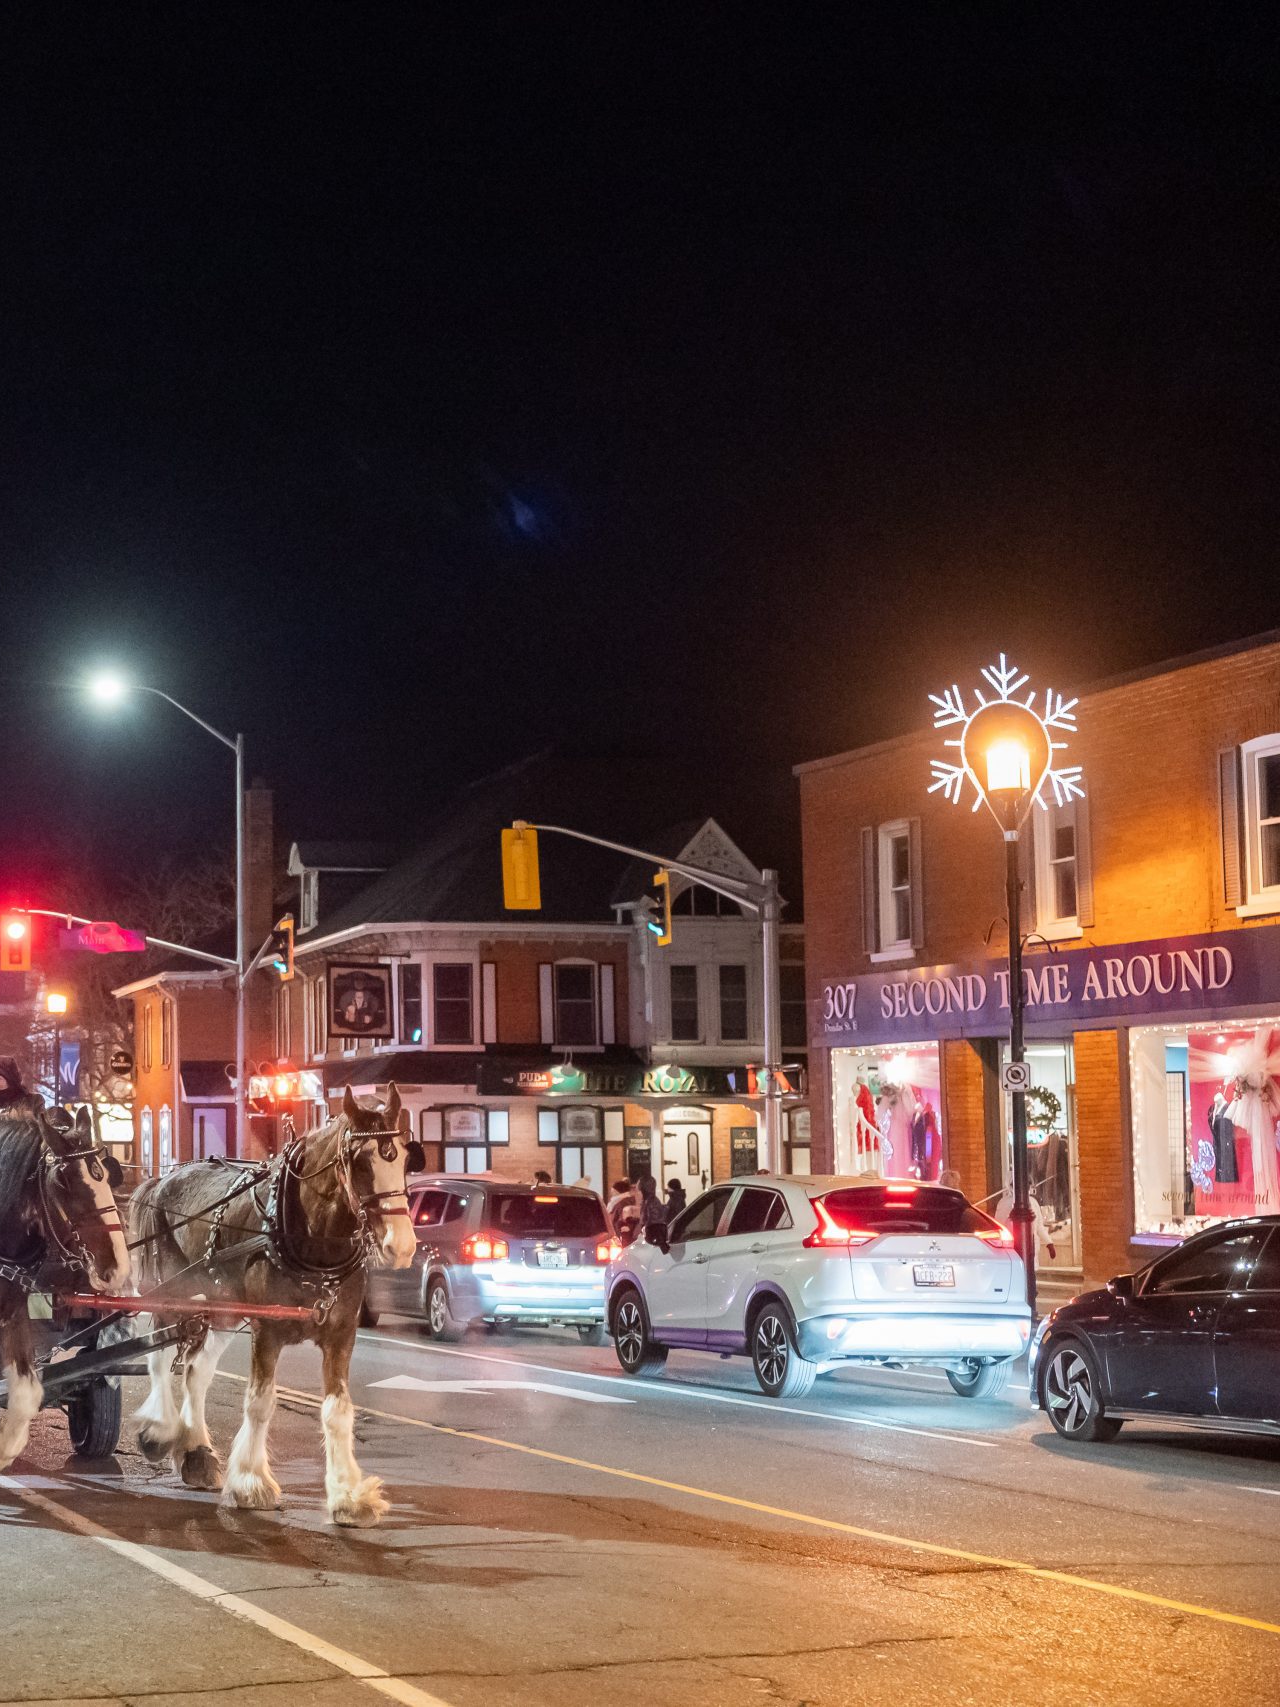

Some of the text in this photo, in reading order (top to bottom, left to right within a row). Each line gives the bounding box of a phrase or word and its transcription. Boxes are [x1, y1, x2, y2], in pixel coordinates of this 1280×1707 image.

[880, 946, 1233, 1019] SECOND TME AROUND
[824, 983, 857, 1020] 307
[824, 1023, 843, 1032] Dundas
[580, 1070, 716, 1093] THE ROYAL
